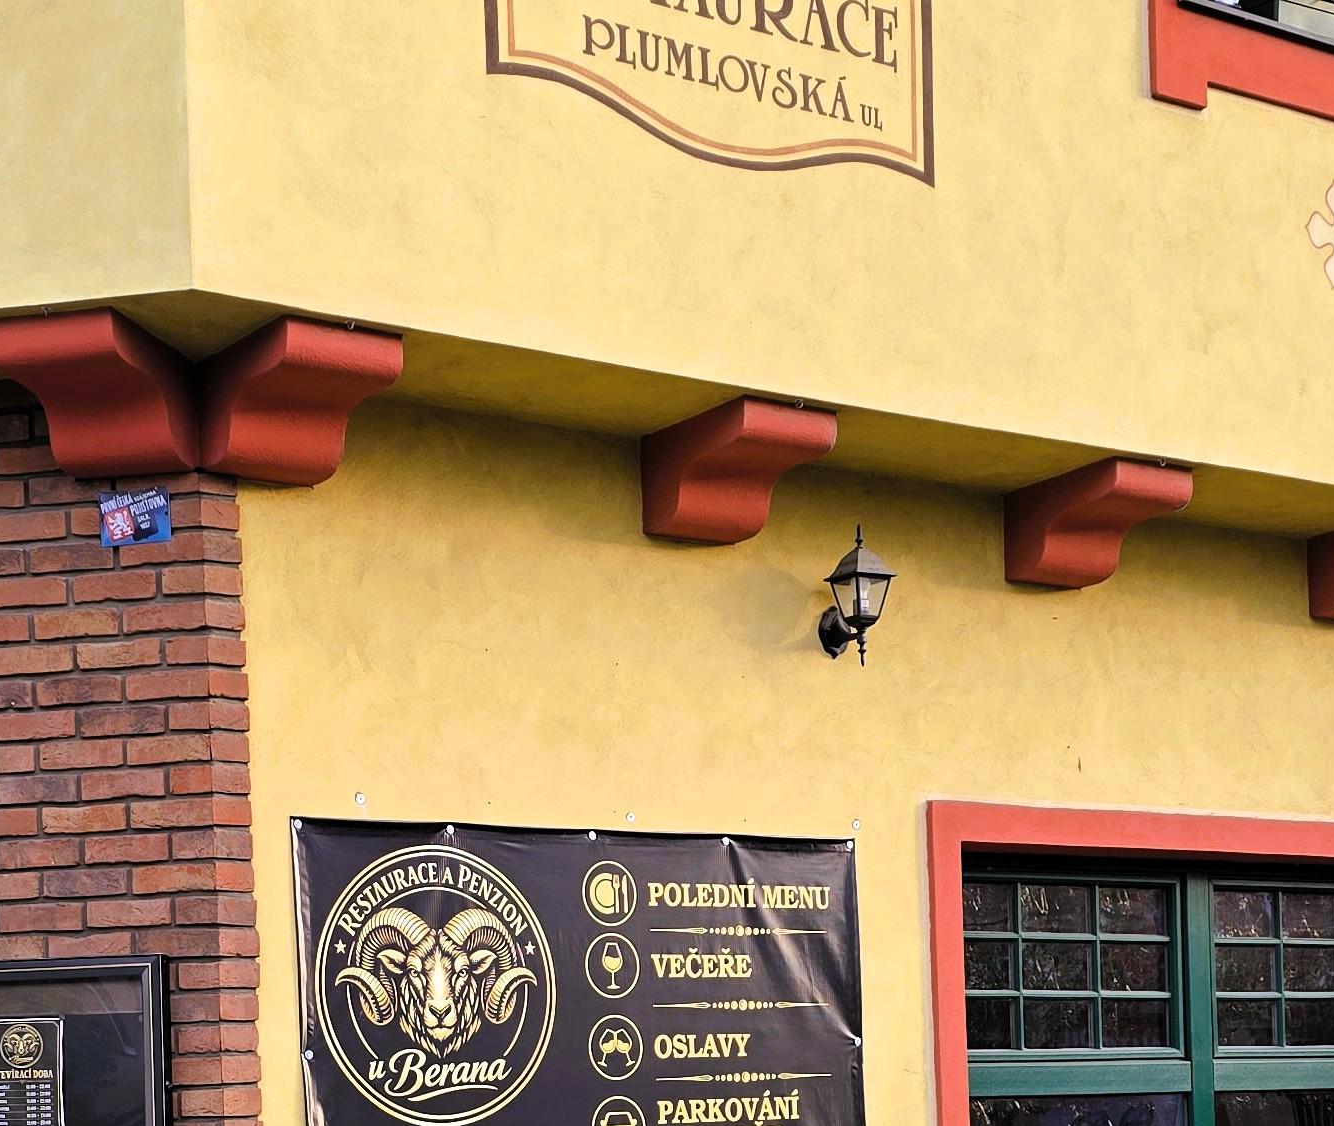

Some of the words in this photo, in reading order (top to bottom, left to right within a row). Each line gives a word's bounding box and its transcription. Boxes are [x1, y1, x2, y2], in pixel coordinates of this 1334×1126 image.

[582, 14, 855, 123] PLUMLOVSKÁ
[859, 103, 883, 132] UL
[338, 862, 438, 937] RESTAURACE
[442, 867, 454, 885] A
[457, 863, 529, 937] PENZION
[648, 877, 757, 908] POLEDNÍ
[762, 885, 830, 910] MENU
[651, 947, 752, 978] VEČEŘE
[653, 1033, 751, 1059] OSLAVY
[369, 1058, 387, 1081] u
[384, 1048, 512, 1097] Berana
[657, 1088, 800, 1125] PARKOVÁNÍ
